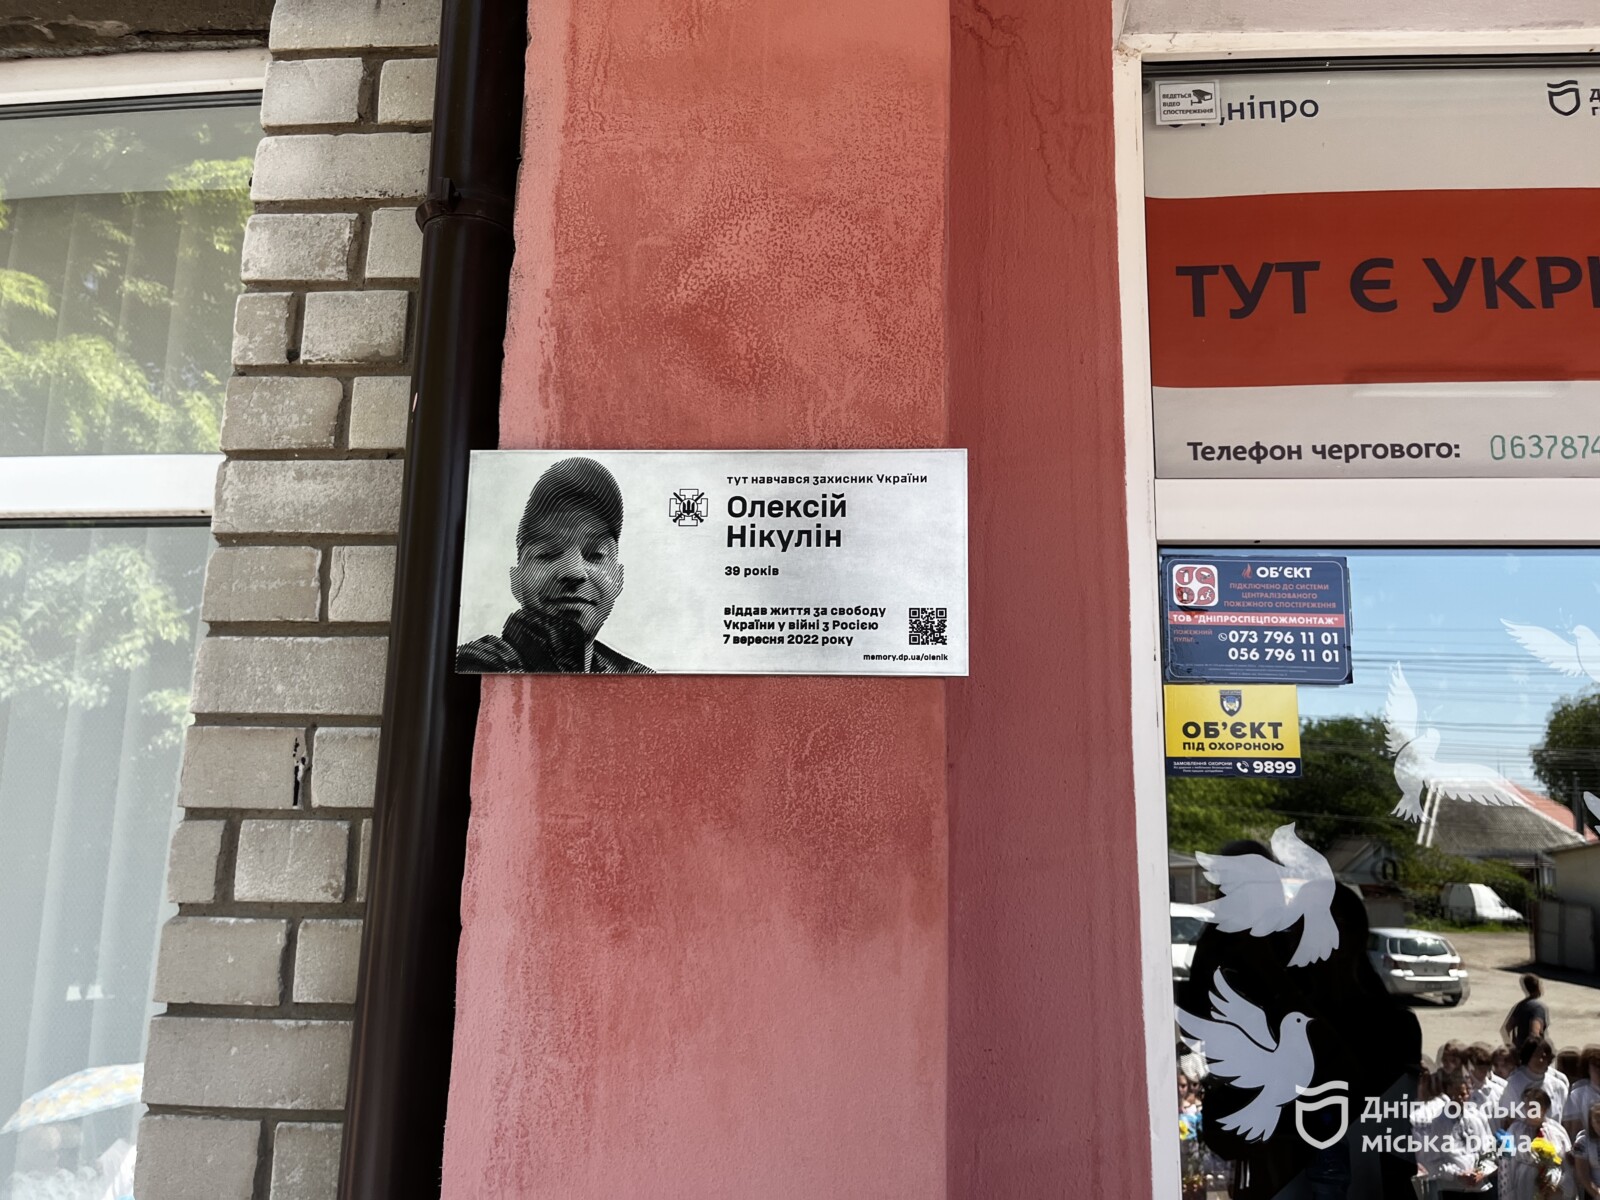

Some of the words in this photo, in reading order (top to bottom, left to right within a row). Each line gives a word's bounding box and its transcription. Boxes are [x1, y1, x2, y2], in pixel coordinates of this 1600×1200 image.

[1219, 95, 1319, 125] ніпро
[1176, 261, 1320, 319] ТУТ
[1350, 257, 1398, 313] Є
[1187, 441, 1302, 464] Телефон
[1312, 440, 1461, 464] чергового:
[727, 475, 748, 486] тут
[751, 475, 810, 484] навчався
[812, 475, 874, 486] захисник
[876, 474, 928, 486] України
[727, 492, 847, 518] Олексій
[726, 524, 842, 552] Нікулін
[724, 566, 740, 576] 39
[744, 565, 780, 578] років
[1242, 592, 1318, 600] ЦЕНТРАЛІЗОВАНОГО
[724, 605, 768, 617] віддав
[770, 606, 810, 616] життя
[813, 607, 828, 617] за
[830, 606, 886, 618] свободу
[1274, 601, 1337, 609] СПОСТЕРЕЖЕННЯ
[1173, 614, 1192, 622] ТОВ
[723, 620, 775, 632] України
[777, 621, 786, 632] у
[788, 619, 820, 630] війні
[822, 621, 830, 632] з
[832, 620, 879, 630] Росією
[723, 634, 730, 644] 7
[732, 635, 784, 646] вересня
[787, 634, 819, 644] 2022
[821, 635, 854, 646] року
[1228, 630, 1258, 644] 073
[1264, 631, 1294, 644] 796
[1300, 632, 1314, 644] 11
[1320, 632, 1339, 646] 01
[863, 652, 948, 662] memory.dp.ua/olenik
[1228, 648, 1260, 660] 056
[1264, 648, 1296, 662] 796
[1302, 649, 1316, 662] 11
[1322, 650, 1340, 662] 01
[1182, 722, 1282, 739] ОБ’ЄКТ
[1182, 742, 1205, 752] ПІД
[1208, 742, 1284, 751] ОХОРОНОЮ
[1252, 760, 1296, 774] 9899
